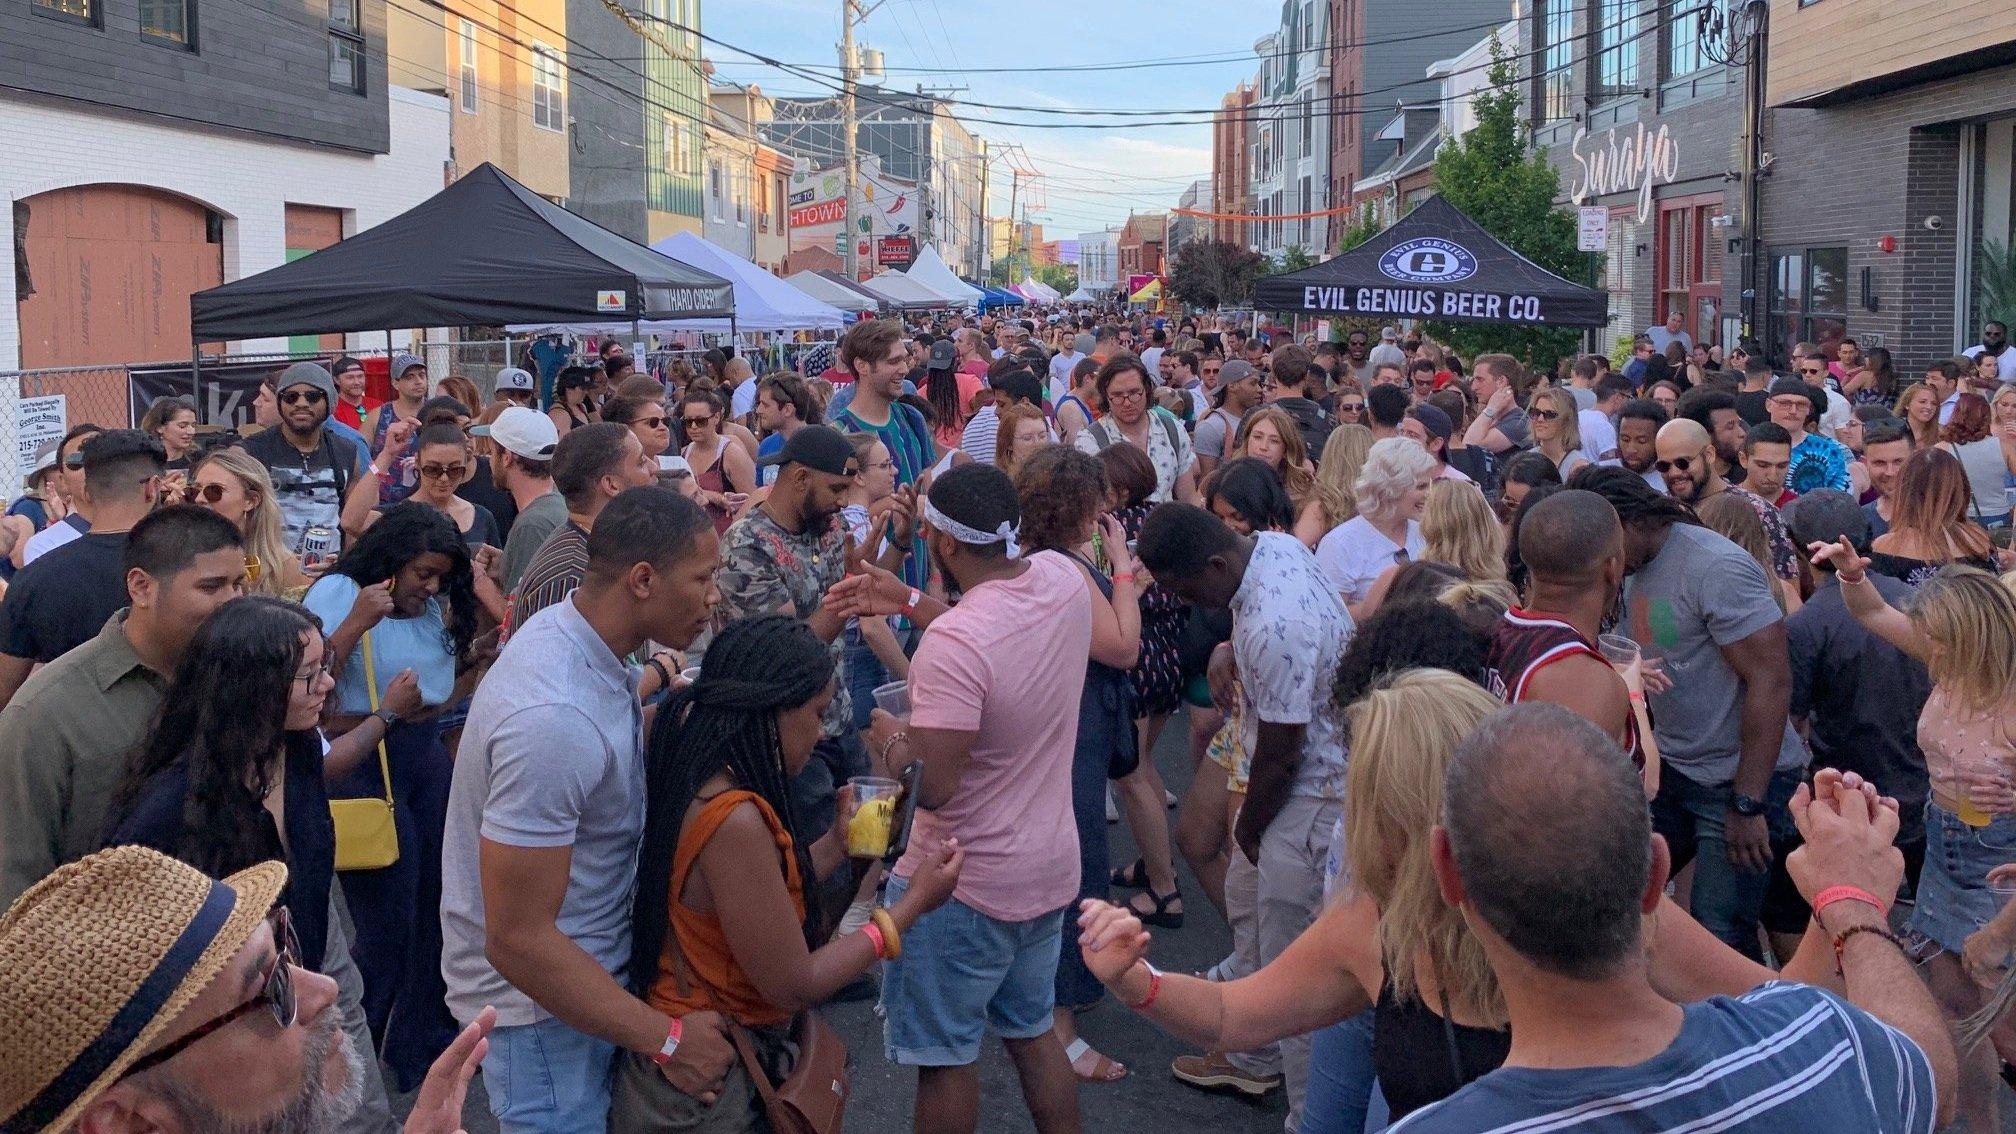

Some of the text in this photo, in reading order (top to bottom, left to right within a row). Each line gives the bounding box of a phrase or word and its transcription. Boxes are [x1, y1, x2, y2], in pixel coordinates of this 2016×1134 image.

[1570, 121, 1679, 224] Suraya
[804, 190, 813, 200] TO
[1390, 239, 1469, 260] EVIL GENIUS
[1384, 263, 1471, 282] BEER COMPANY
[670, 288, 715, 311] HARD CIDER
[1303, 286, 1545, 321] EVIL GENIUS BEER CO.
[19, 413, 61, 426] George Smith
[305, 537, 326, 551] Lite
